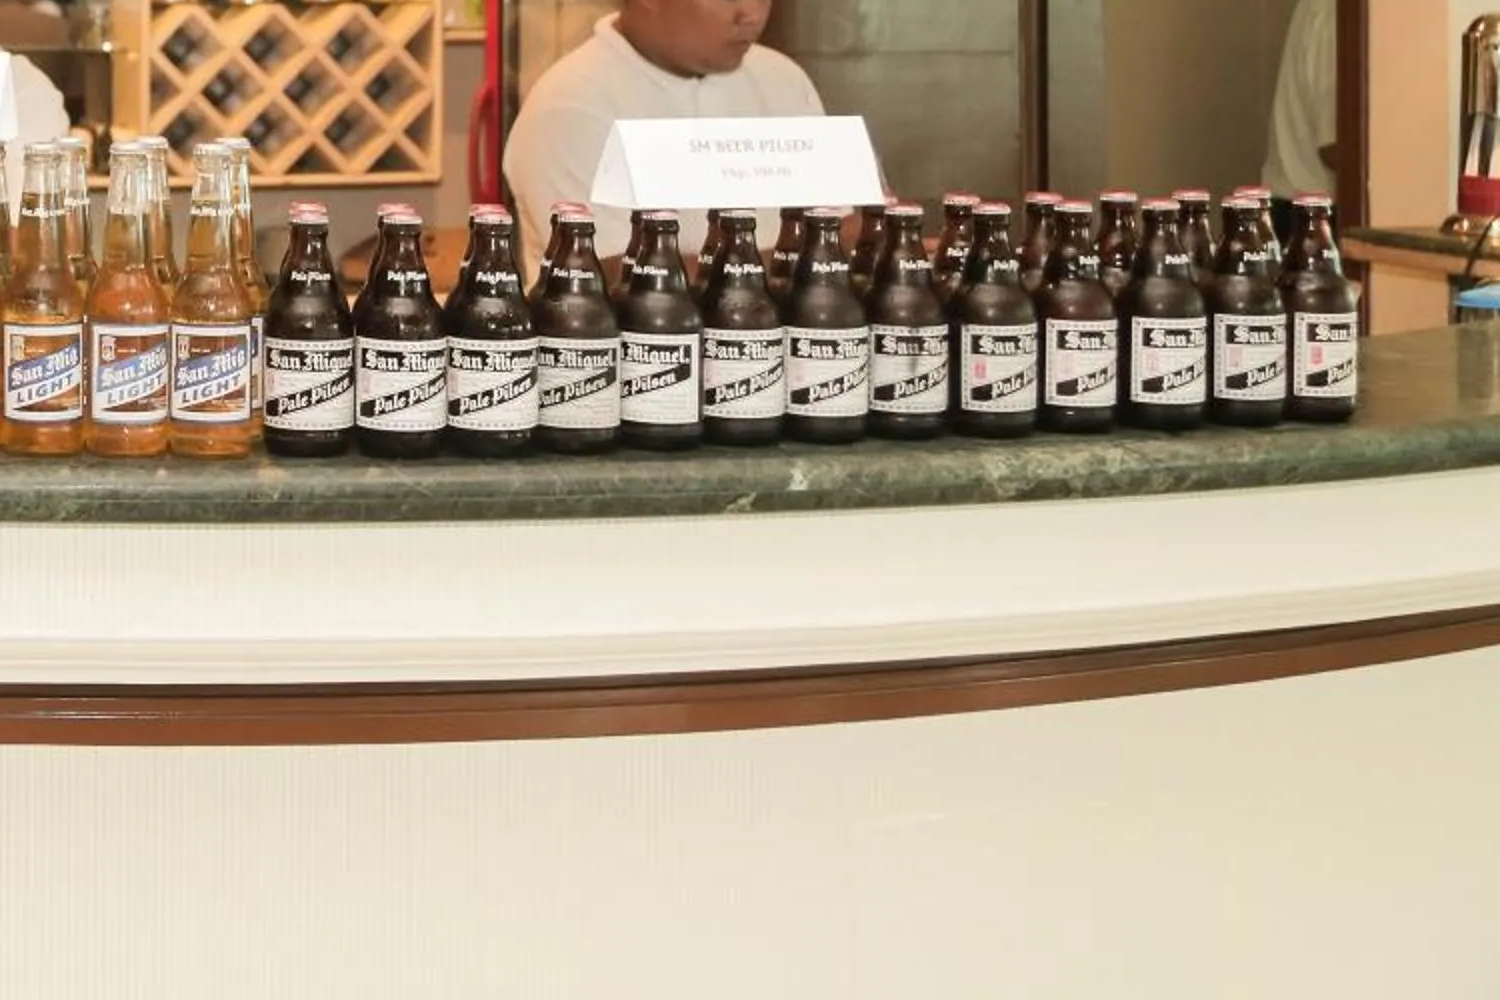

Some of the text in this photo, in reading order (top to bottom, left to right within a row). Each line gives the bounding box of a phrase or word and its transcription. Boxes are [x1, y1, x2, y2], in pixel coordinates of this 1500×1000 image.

[1064, 331, 1101, 349] San
[1149, 329, 1188, 347] San
[1233, 325, 1270, 343] San
[1315, 323, 1348, 341] San
[705, 339, 740, 359] San
[797, 339, 835, 359] San
[881, 335, 920, 355] San
[979, 335, 1017, 354] San
[11, 345, 78, 386] San Mig
[176, 346, 246, 387] San Mig
[270, 349, 301, 370] San
[365, 349, 399, 371] San
[451, 349, 483, 370] San
[557, 349, 613, 371] Miguel
[100, 365, 136, 388] San
[631, 371, 677, 396] Pilsen
[1076, 371, 1105, 393] Pale
[1162, 367, 1193, 390] Pale
[17, 374, 73, 403] LIGHT
[107, 373, 163, 404] LIGHT
[181, 373, 241, 404] LIGHT
[564, 378, 607, 401] Pilsen
[715, 382, 747, 404] Pale
[808, 380, 841, 403] Pale
[894, 377, 927, 400] Pale
[991, 376, 1022, 400] Pale
[278, 392, 309, 416] Pale
[374, 393, 407, 415] Pale
[460, 392, 491, 415] Pale
